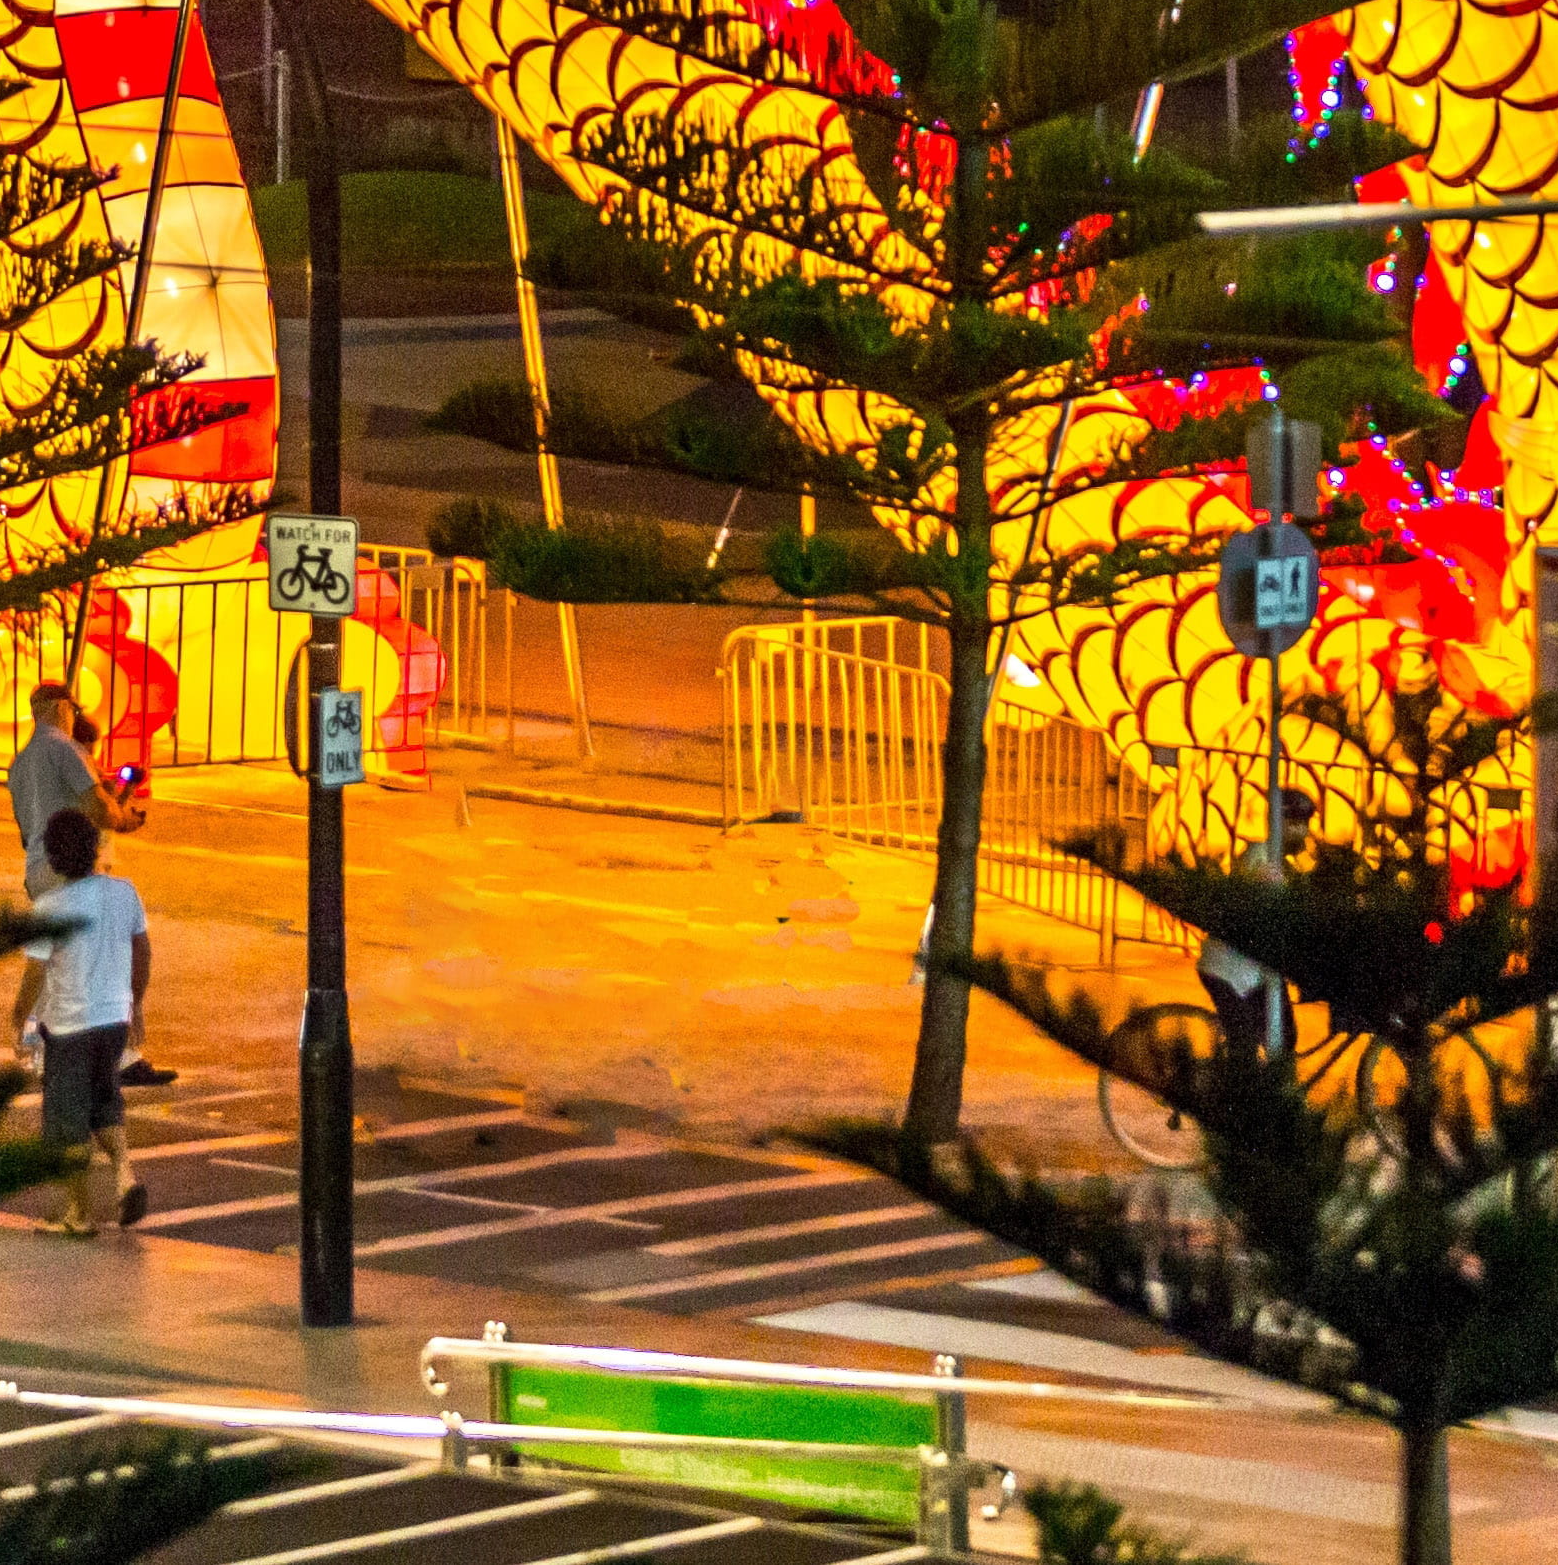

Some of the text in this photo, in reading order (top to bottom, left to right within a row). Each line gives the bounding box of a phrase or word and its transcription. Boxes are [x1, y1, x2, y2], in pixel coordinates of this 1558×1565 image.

[276, 526, 351, 543] WATCH FOR
[326, 750, 360, 774] ONLY
